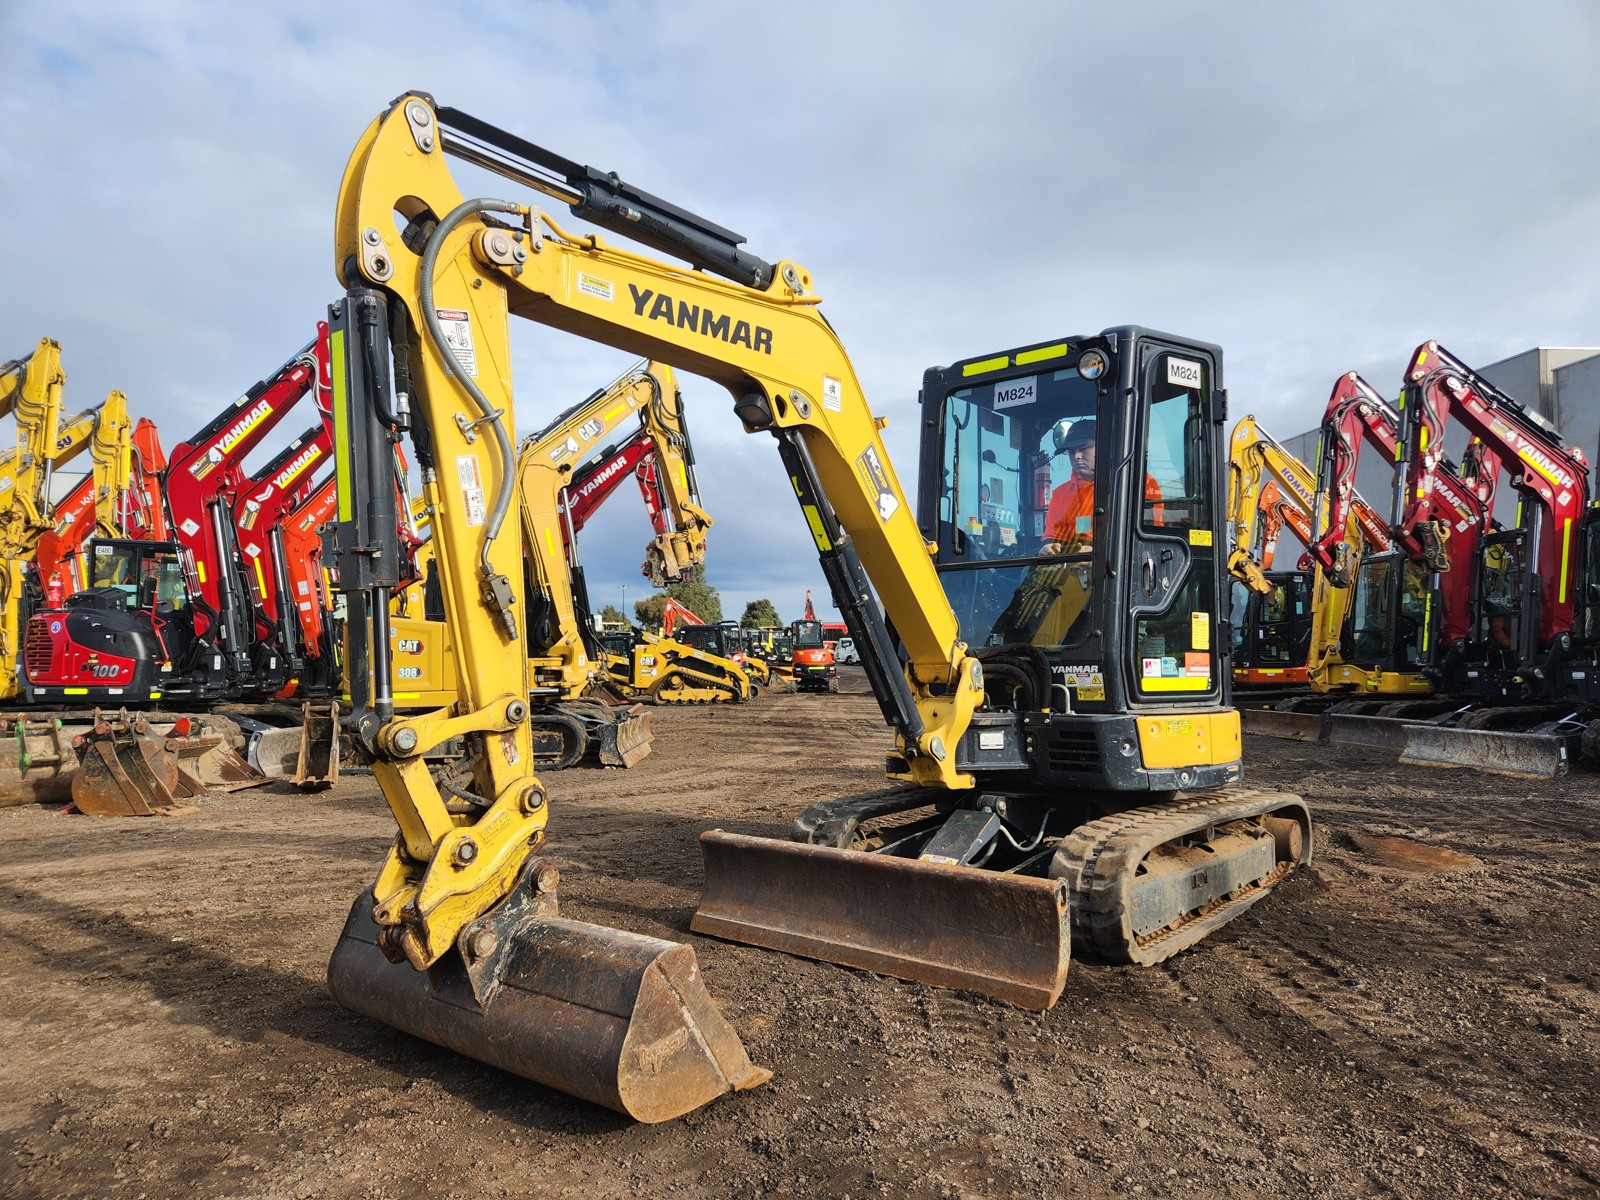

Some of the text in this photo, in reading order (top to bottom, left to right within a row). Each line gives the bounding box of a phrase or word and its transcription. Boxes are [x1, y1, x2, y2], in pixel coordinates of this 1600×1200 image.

[628, 283, 773, 355] YANMAR
[1171, 364, 1198, 381] M824
[997, 386, 1034, 403] M824
[214, 399, 272, 450] YANMAR
[578, 419, 600, 441] CAT
[272, 443, 320, 487] YANMAR
[1516, 437, 1575, 489] YANMAR
[579, 456, 628, 496] YANMAR
[398, 640, 420, 652] CAT
[640, 657, 655, 666] CAT
[1051, 665, 1099, 674] YANMAR
[398, 667, 418, 678] 308
